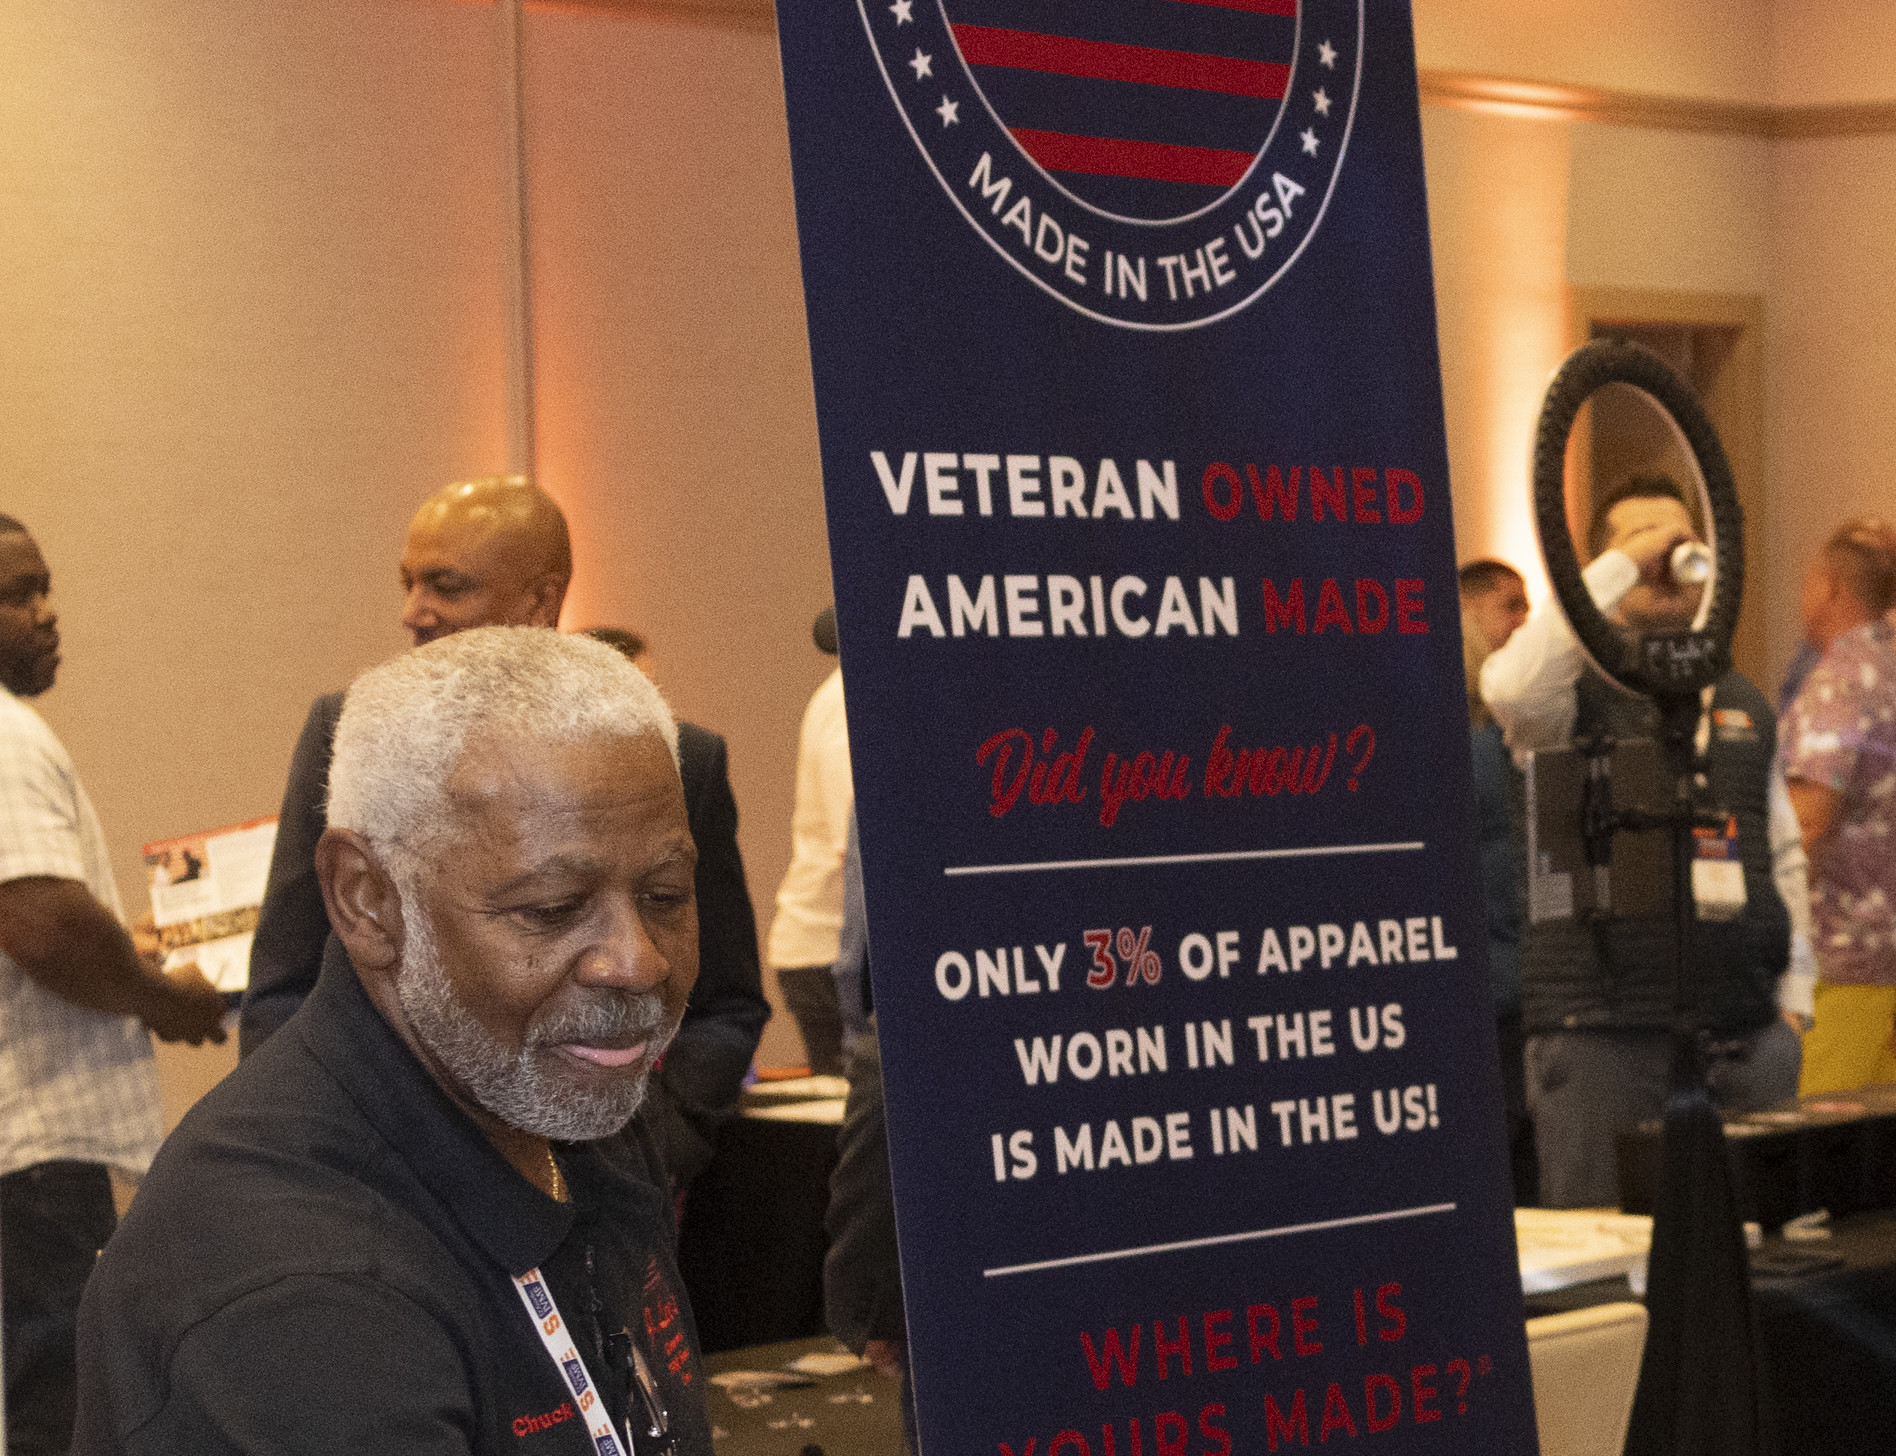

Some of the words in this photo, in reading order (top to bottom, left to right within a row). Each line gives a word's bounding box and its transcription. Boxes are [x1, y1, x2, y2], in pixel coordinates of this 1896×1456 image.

[969, 152, 1088, 284] MADE
[1104, 250, 1148, 301] IN
[1157, 238, 1236, 301] THE
[1234, 171, 1305, 260] USA
[870, 450, 1181, 520] VETERAN
[1201, 463, 1425, 524] OWNED
[897, 574, 1240, 638] AMERICAN
[1262, 577, 1430, 635] MADE
[977, 726, 1095, 818] Did
[1100, 748, 1193, 827] you
[1203, 724, 1377, 798] know?
[934, 942, 1067, 1001] ONLY
[1083, 926, 1163, 988] 3%
[1178, 931, 1240, 981] OF
[1256, 916, 1457, 975] APPAREL
[1014, 1025, 1169, 1086] WORN
[1185, 1018, 1236, 1069] IN
[1247, 1009, 1336, 1062] THE
[1348, 1003, 1407, 1052] US
[991, 1131, 1038, 1182] IS
[1053, 1112, 1195, 1173] MADE
[1209, 1105, 1259, 1155] IN
[1271, 1094, 1359, 1147] THE
[1372, 1084, 1441, 1134] US!
[1080, 1295, 1325, 1392] WHERE
[1353, 1281, 1408, 1347] IS
[512, 1403, 574, 1438] Chuck
